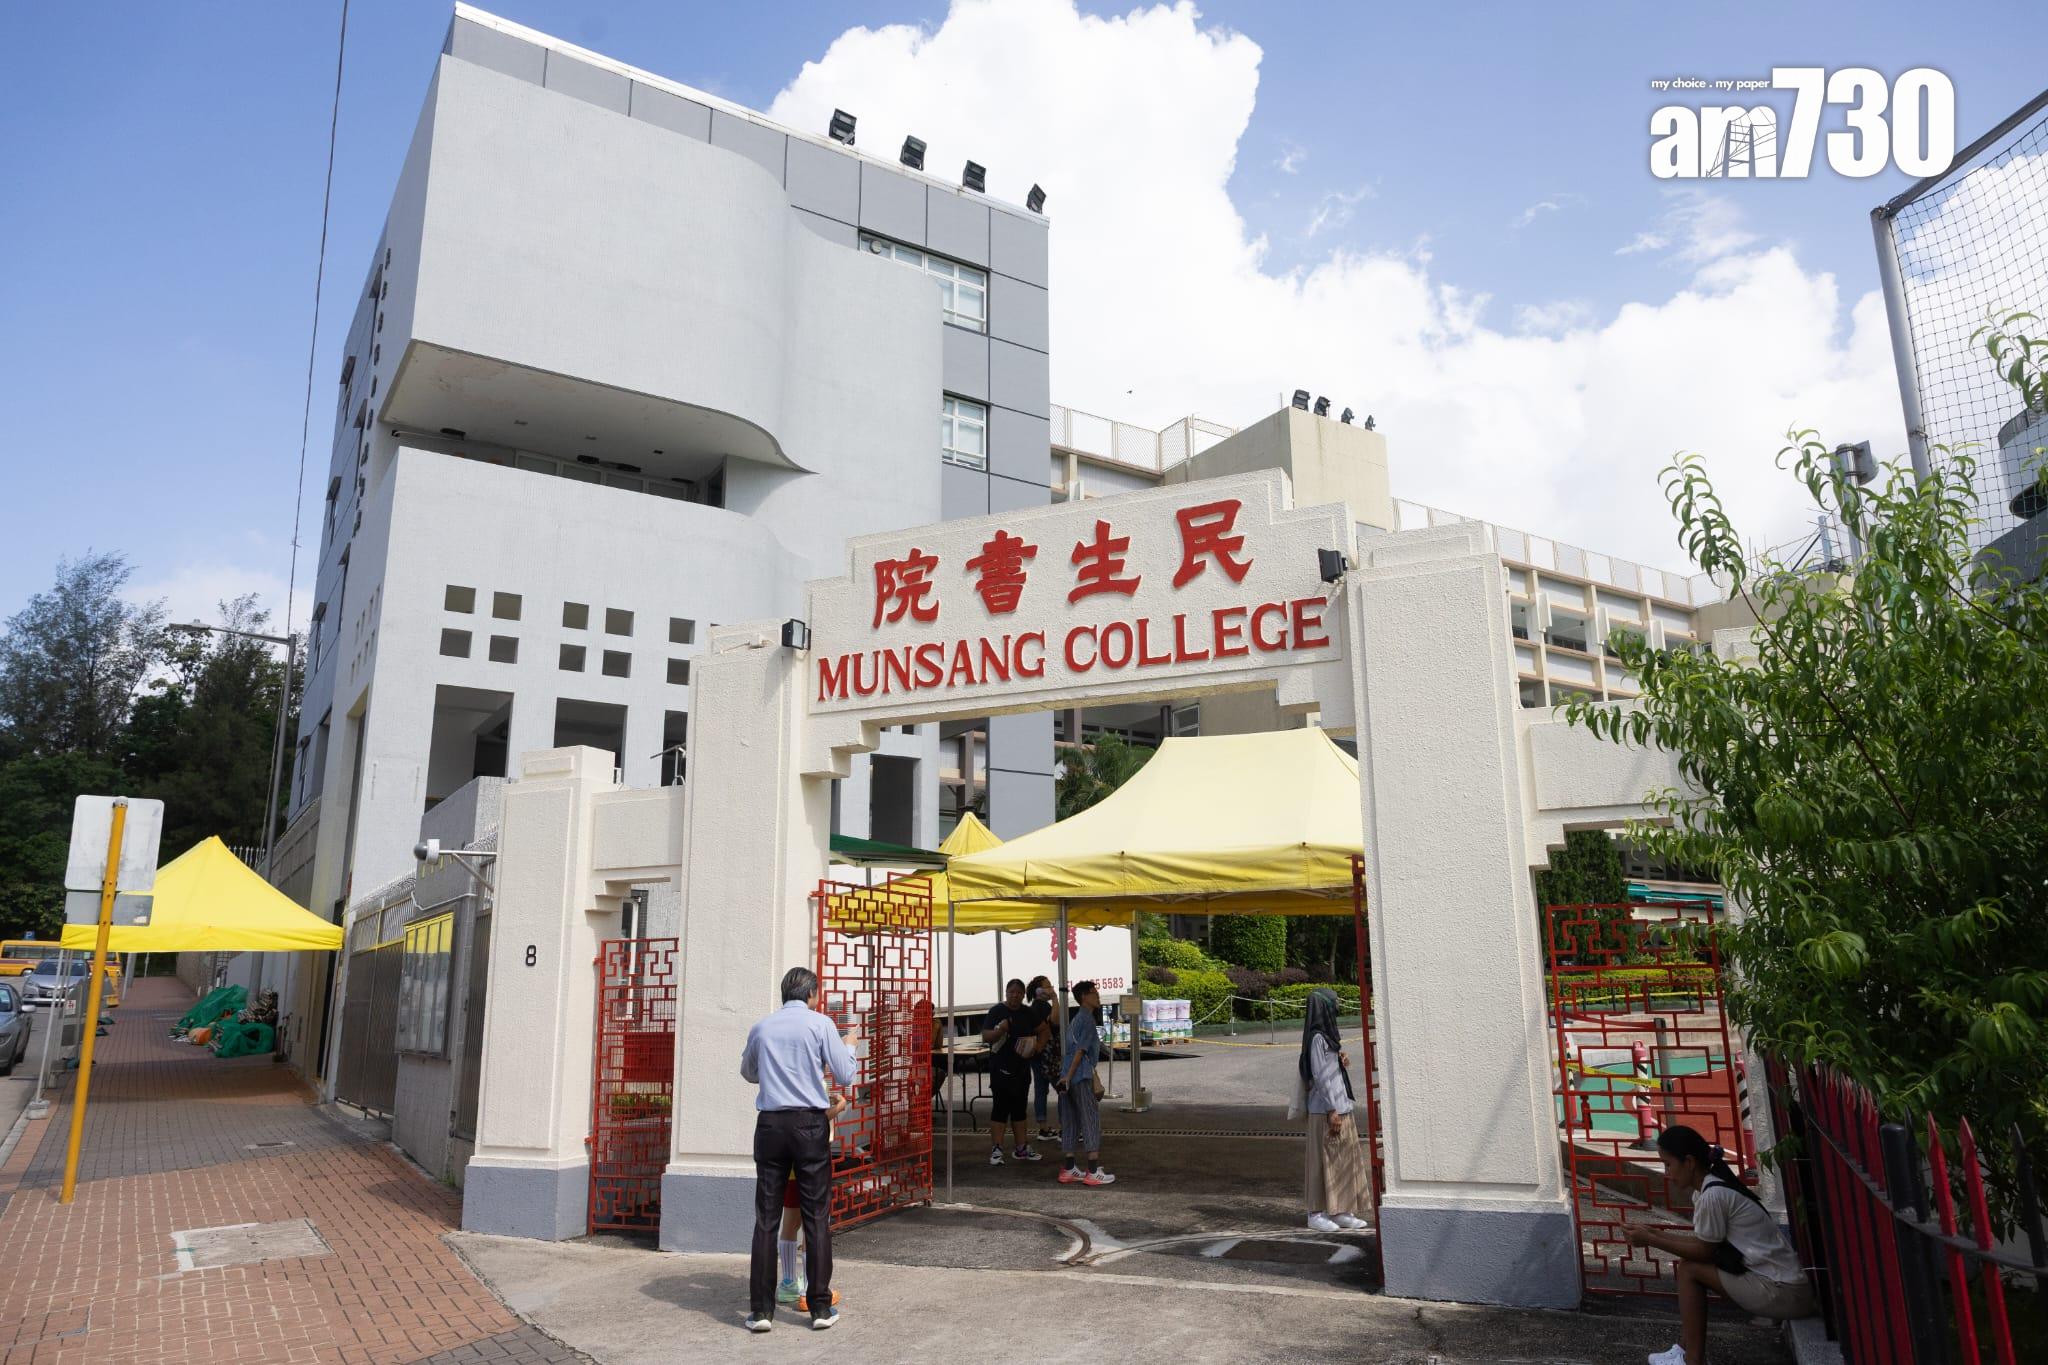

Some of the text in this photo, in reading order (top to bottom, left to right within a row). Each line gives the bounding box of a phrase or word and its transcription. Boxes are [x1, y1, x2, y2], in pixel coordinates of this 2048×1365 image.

[818, 597, 1330, 701] MUNSANG COLLEGE
[525, 944, 537, 967] 8
[1102, 977, 1124, 989] 5583
